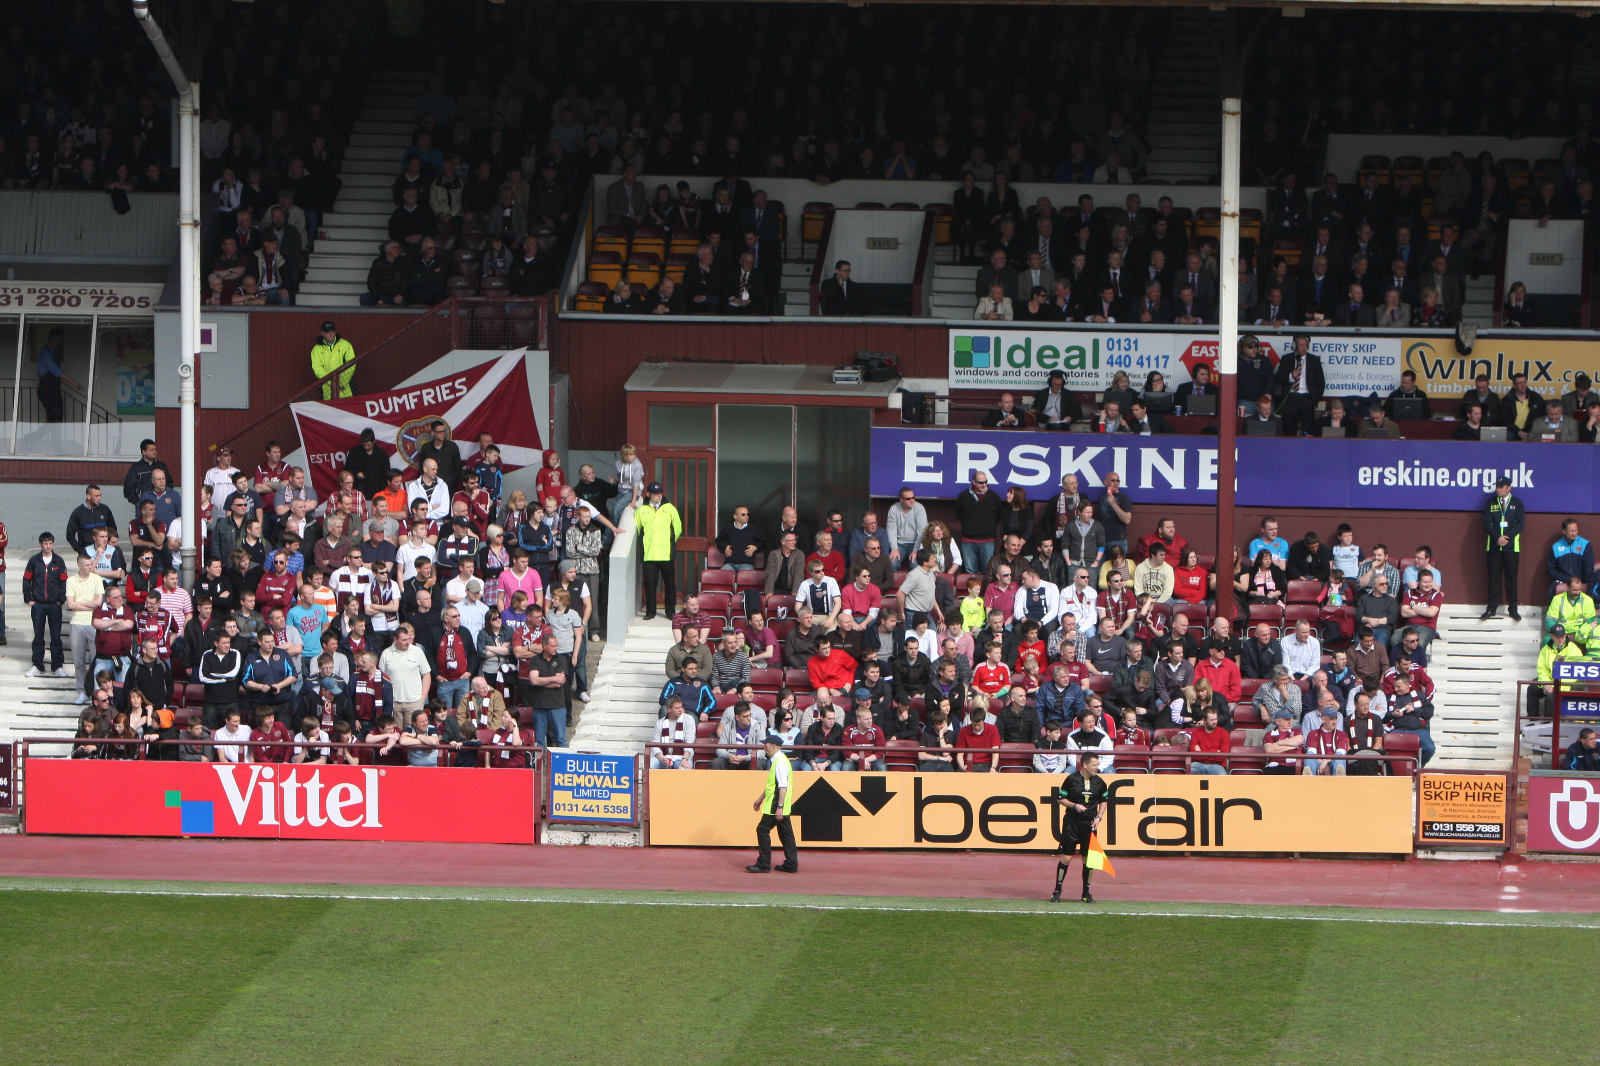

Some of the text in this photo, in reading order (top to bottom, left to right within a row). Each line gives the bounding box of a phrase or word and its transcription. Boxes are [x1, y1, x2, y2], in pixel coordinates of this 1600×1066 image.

[27, 287, 72, 295] BOOK
[78, 288, 117, 296] CALL
[36, 294, 81, 308] 200
[90, 296, 151, 309] 7205
[1106, 337, 1139, 352] 0131
[1312, 342, 1377, 353] EVERY SKIP
[993, 336, 1100, 370] Ideal
[1106, 354, 1170, 369] 440 4117
[1328, 355, 1359, 366] EVER
[1362, 355, 1395, 366] NEED
[955, 368, 999, 377] windows
[1002, 368, 1021, 377] and
[1325, 371, 1394, 381] Lothians & Borders
[1426, 382, 1475, 394] timbe
[365, 377, 468, 418] DUMFRIES
[902, 440, 1238, 491] ERSKINE
[1567, 701, 1600, 711] ERS
[566, 759, 619, 774] BULLET
[554, 772, 631, 789] REMOVALS
[1423, 780, 1504, 792] BUCHANAN
[212, 764, 383, 828] Vittel
[573, 788, 610, 799] LIMITED
[1423, 790, 1503, 803] SKIP HIRE
[554, 802, 629, 815] 0131 441 5358
[1432, 823, 1453, 832] 0131
[1455, 824, 1475, 832] 558
[1475, 824, 1500, 833] 7888
